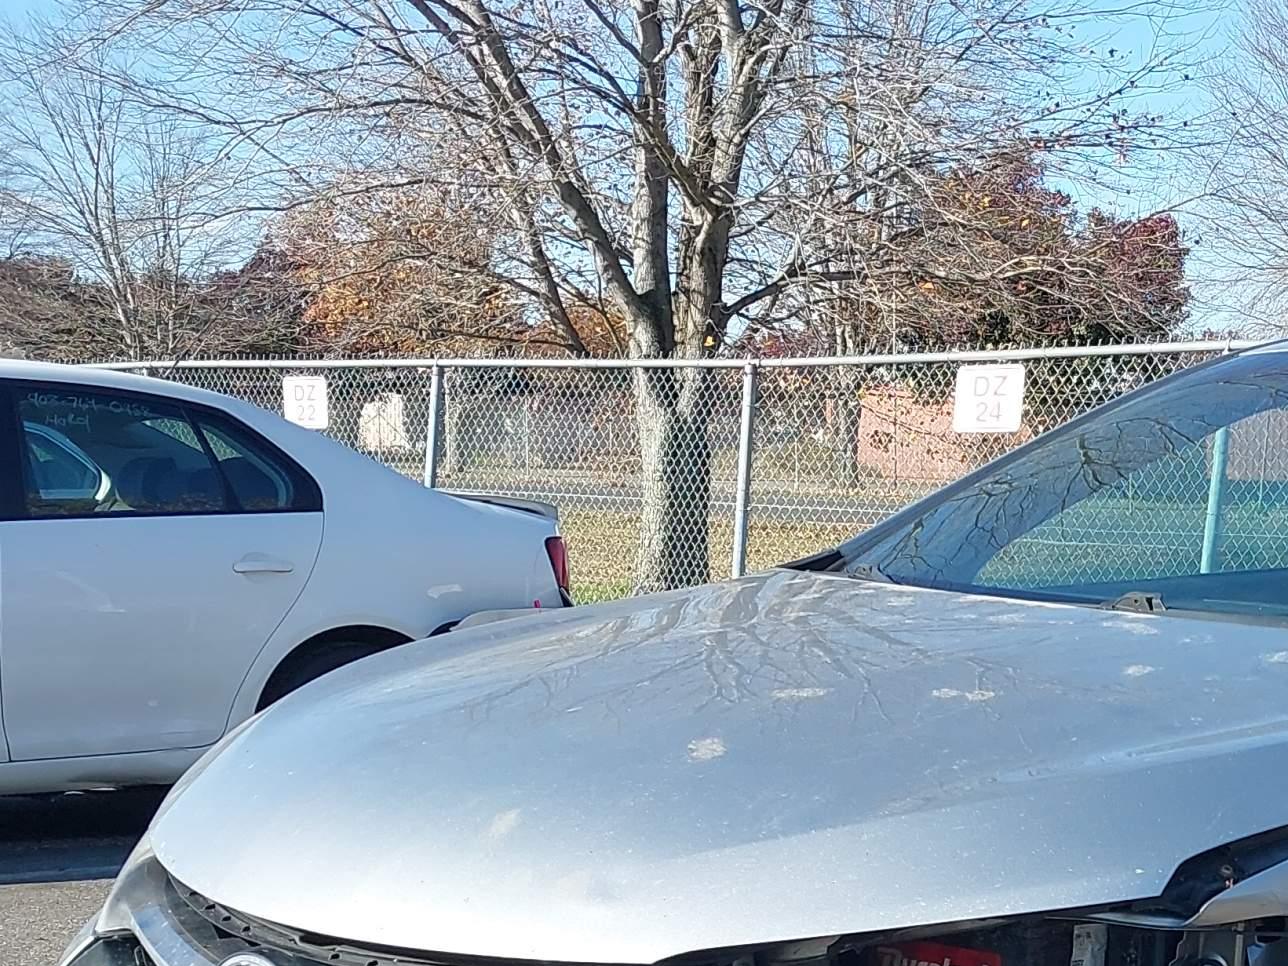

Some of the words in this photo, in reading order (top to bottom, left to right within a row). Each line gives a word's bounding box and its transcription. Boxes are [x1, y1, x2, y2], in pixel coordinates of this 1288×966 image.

[294, 384, 317, 401] DZ
[974, 375, 1008, 397] DZ
[296, 404, 316, 421] 22
[975, 401, 1003, 422] 24
